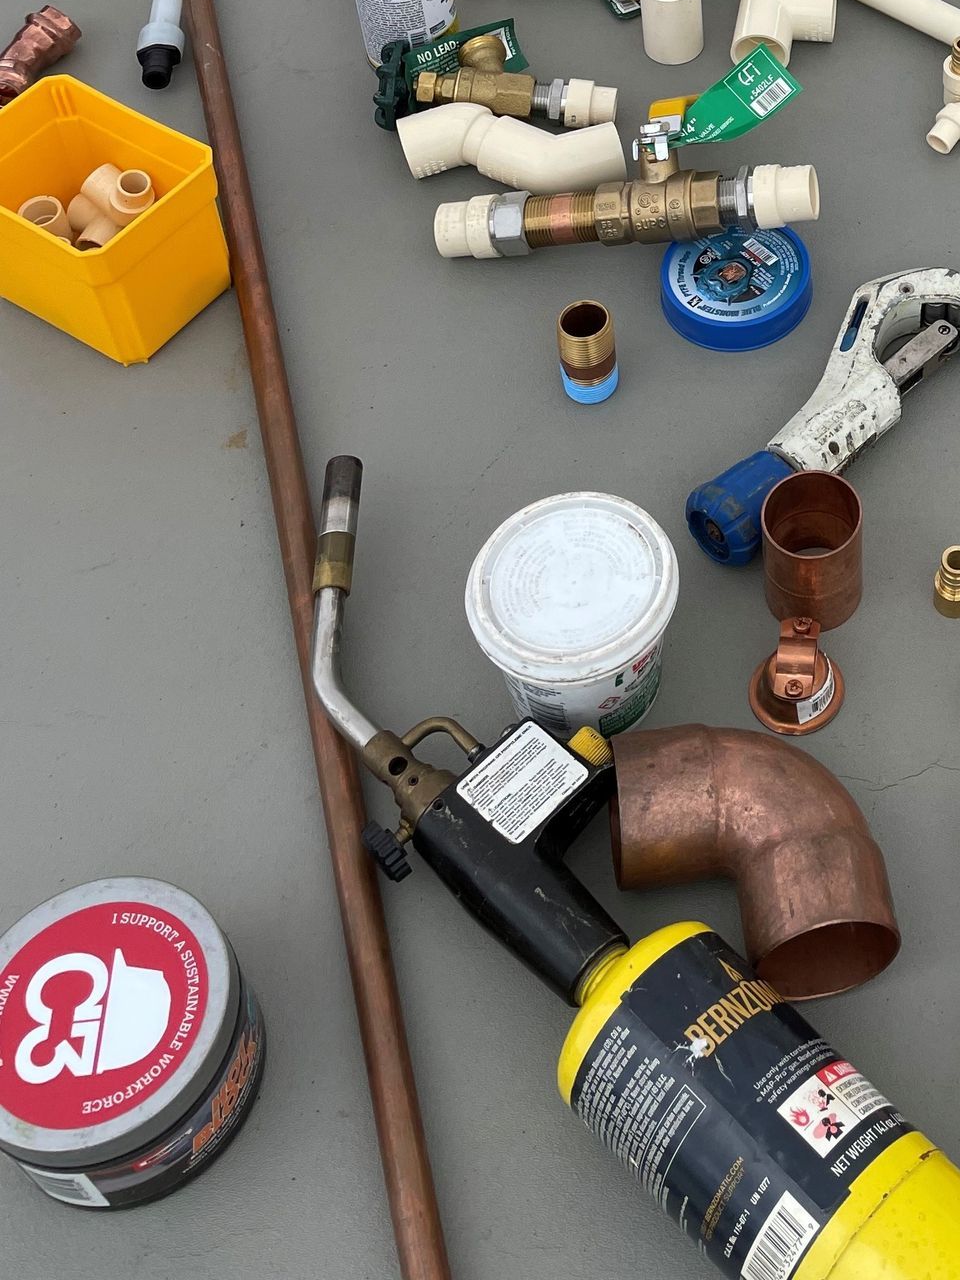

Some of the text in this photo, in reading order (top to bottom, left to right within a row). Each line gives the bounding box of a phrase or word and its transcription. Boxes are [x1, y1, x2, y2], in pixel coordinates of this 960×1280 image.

[416, 40, 461, 64] NO LEAD:
[699, 123, 716, 139] VALVE
[81, 912, 200, 1115] I SUPPORT A SUSTAINABLE WORKFORCE
[753, 1076, 767, 1090] Use
[766, 1066, 780, 1079] only
[777, 1055, 791, 1068] with
[767, 1084, 788, 1104] safety
[785, 1062, 811, 1086] warnings
[830, 1155, 851, 1177] NET
[847, 1128, 878, 1160] WEIGHT
[723, 1168, 745, 1201] SUPPORT
[750, 1176, 771, 1206] UN 1077
[733, 1209, 751, 1235] 115-07-1
[784, 1238, 803, 1267] 32477
[808, 1223, 814, 1231] 9
